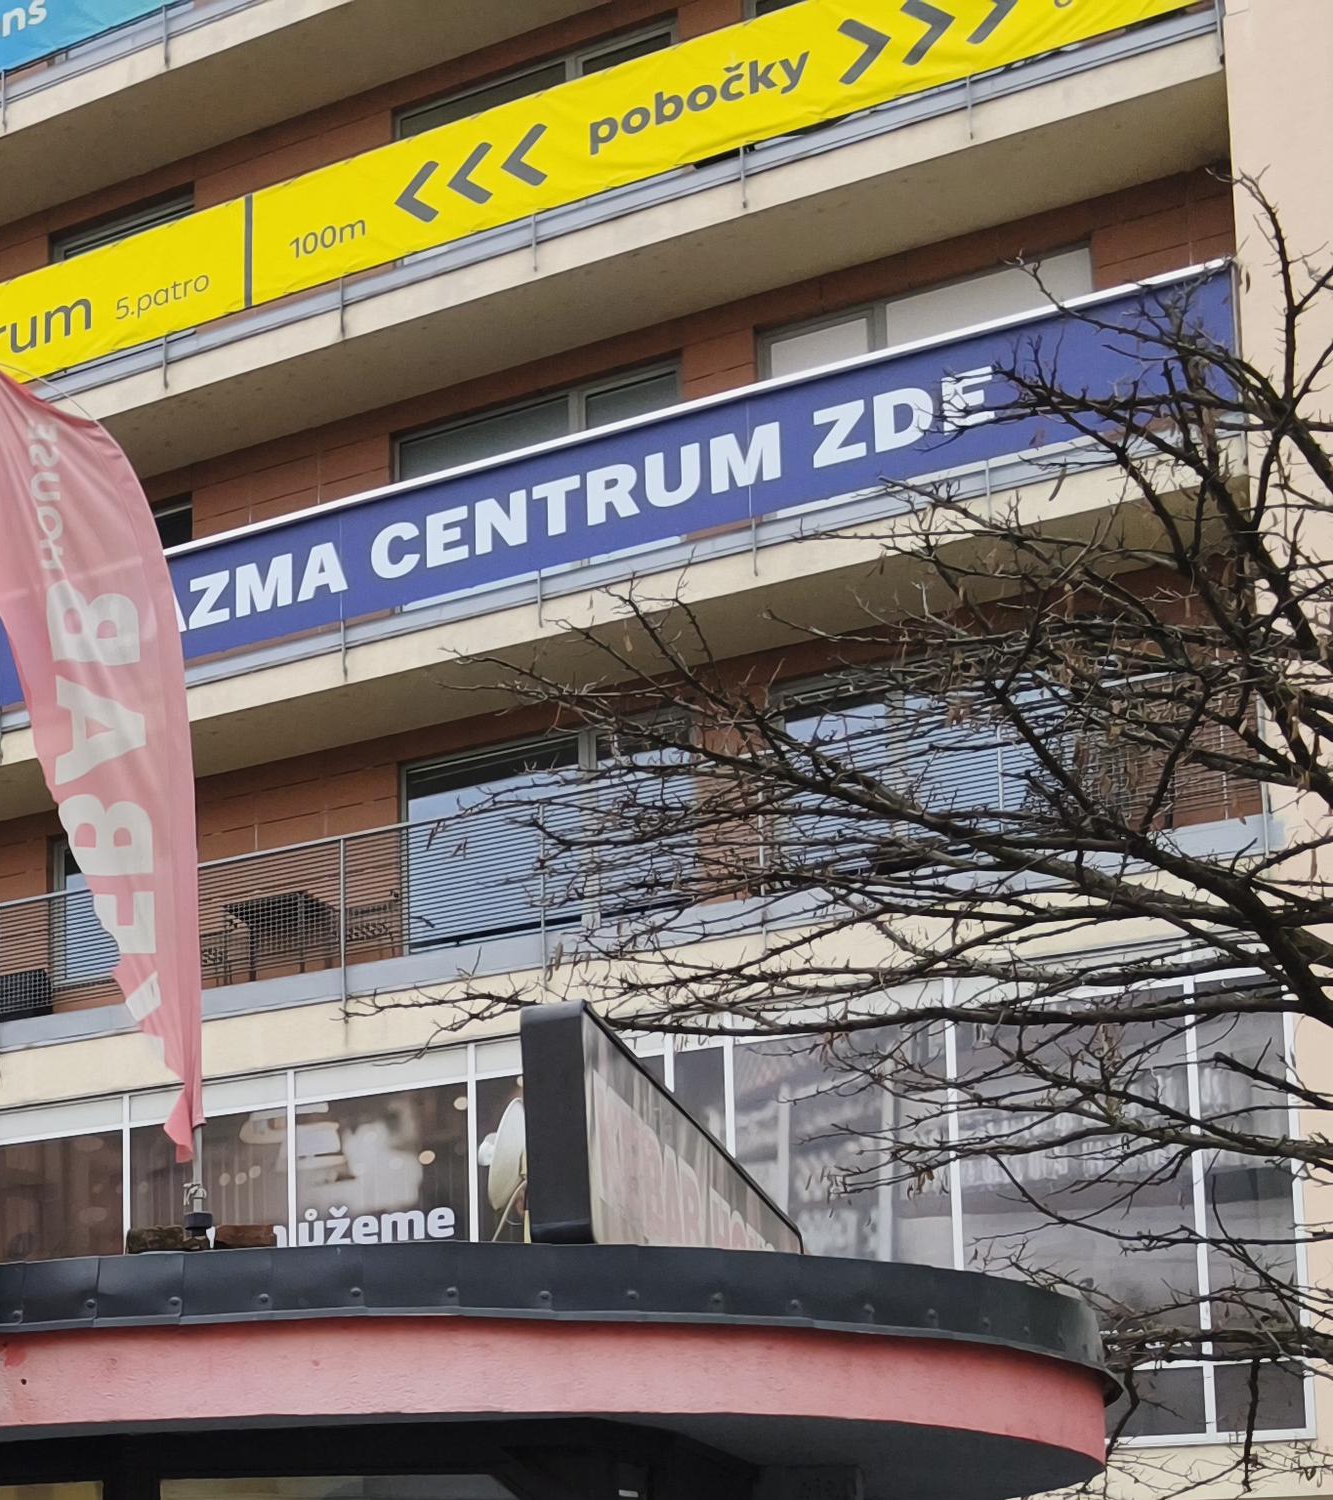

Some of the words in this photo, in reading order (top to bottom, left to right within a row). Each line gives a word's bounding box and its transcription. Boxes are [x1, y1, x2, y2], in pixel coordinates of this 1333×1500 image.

[588, 51, 810, 155] pobočky
[288, 217, 367, 260] 100m
[114, 270, 211, 325] 5.patro
[174, 541, 350, 633] ZMA
[370, 420, 782, 581] CENTRUM
[813, 366, 996, 468] ZDE
